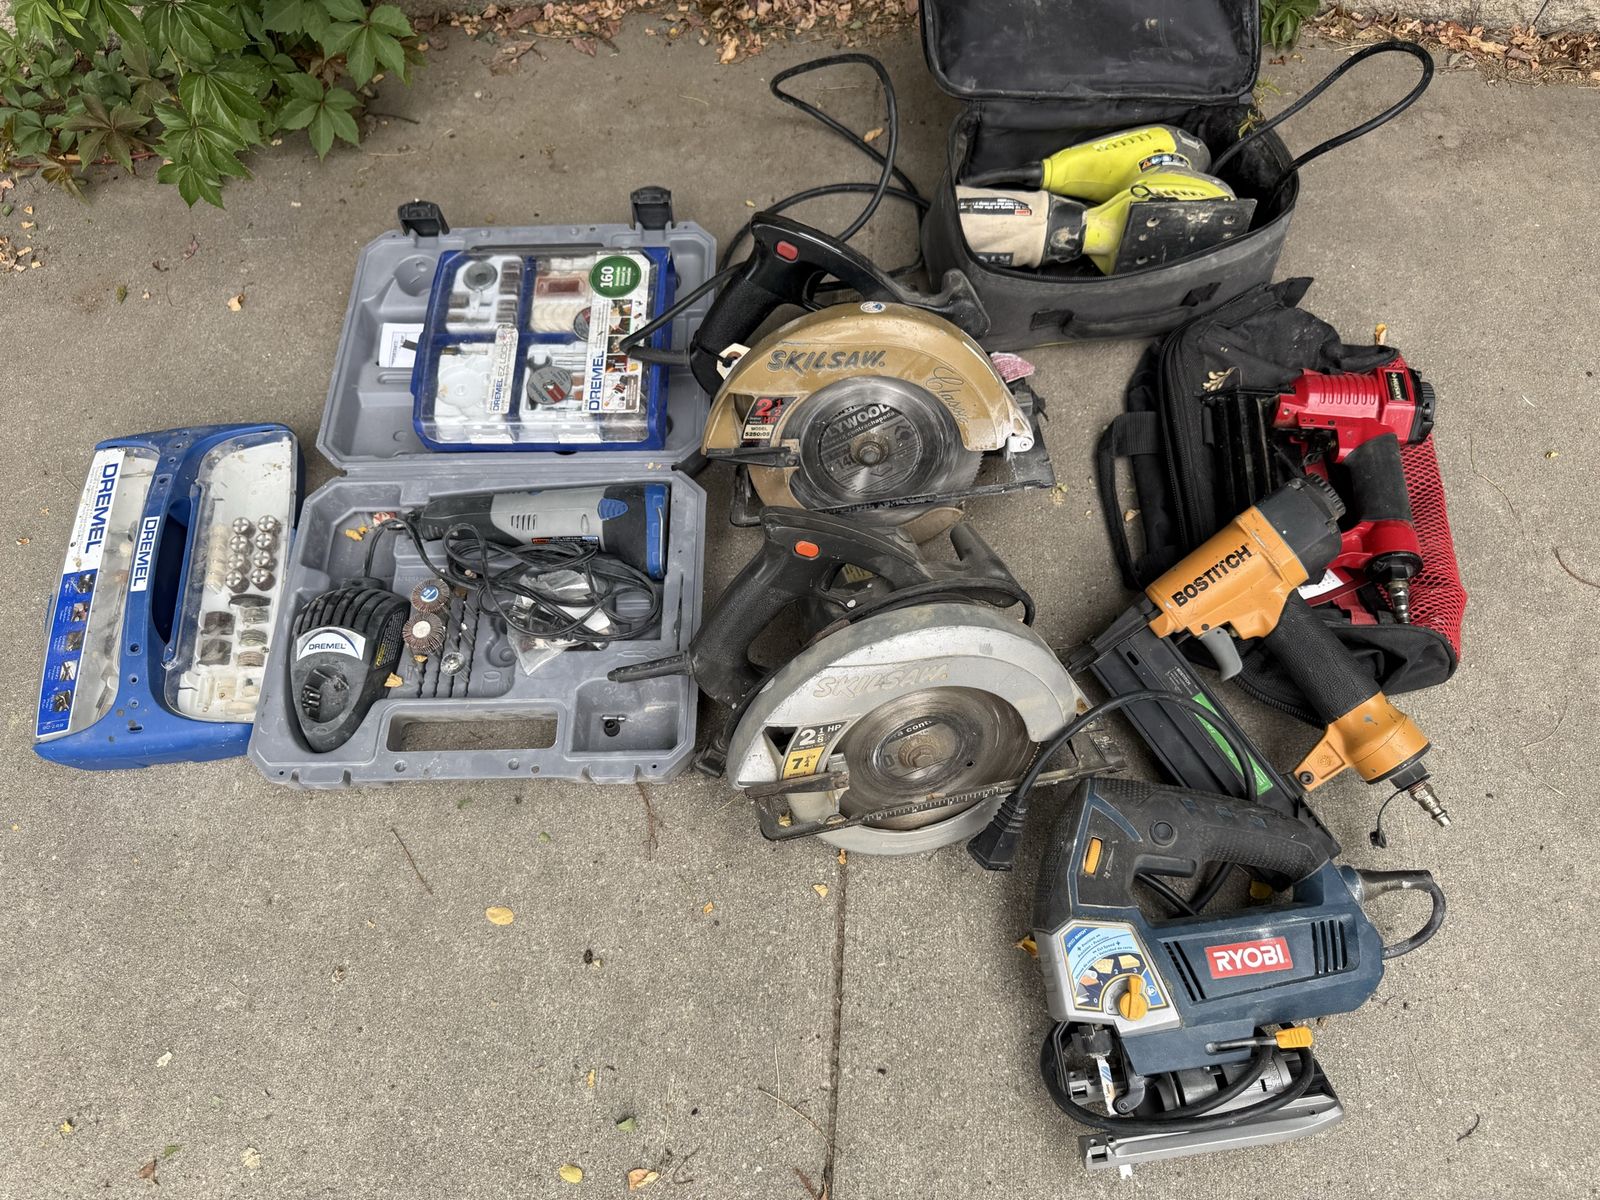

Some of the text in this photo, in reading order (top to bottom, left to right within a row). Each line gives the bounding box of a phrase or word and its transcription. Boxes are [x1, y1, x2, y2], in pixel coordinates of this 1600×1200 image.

[600, 265, 614, 288] 160
[766, 350, 886, 377] SKILSAW
[492, 378, 504, 411] DREMEL
[499, 366, 507, 377] EZ
[589, 350, 605, 412] DREMEL
[924, 366, 969, 425] Classic
[754, 398, 773, 416] 2
[826, 404, 890, 437] LYWOOD
[85, 462, 119, 554] DREMEL
[133, 519, 158, 587] DREMEL
[1172, 545, 1252, 607] BOSTITCH
[308, 641, 347, 651] DREMEL
[799, 728, 816, 746] 2
[827, 724, 842, 733] HP
[792, 757, 804, 770] 7
[1212, 944, 1285, 971] RYOBI
